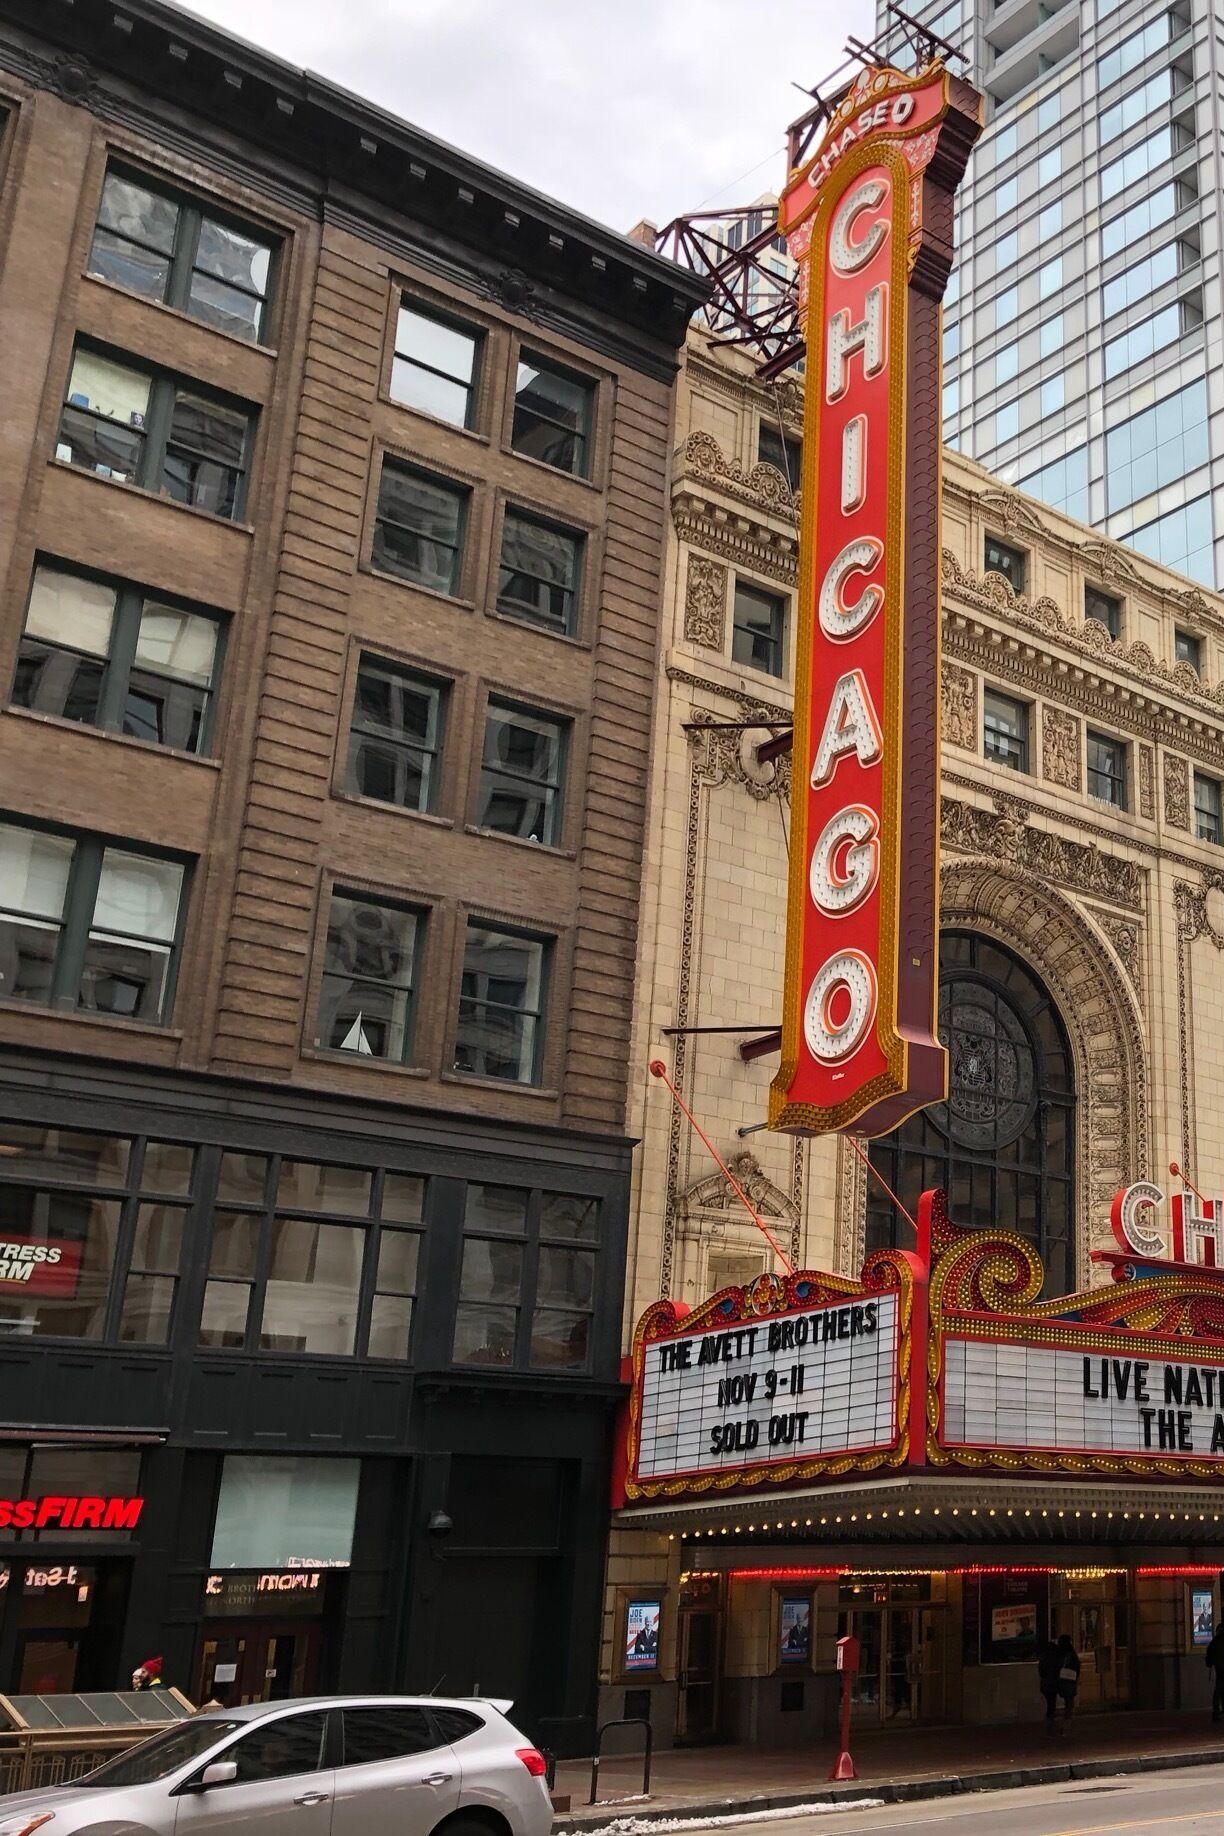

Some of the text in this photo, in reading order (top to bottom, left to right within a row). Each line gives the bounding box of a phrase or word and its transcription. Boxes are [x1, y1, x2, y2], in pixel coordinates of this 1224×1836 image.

[807, 99, 888, 190] CHASE
[804, 178, 890, 1067] CHICAGO
[659, 1303, 878, 1373] THE AVETT BROTHERS
[717, 1364, 805, 1407] NOV 9-11
[1083, 1356, 1149, 1402] LIVE
[710, 1412, 809, 1454] SOLD OUT
[1140, 1408, 1193, 1451] THE
[629, 1609, 643, 1618] JOE
